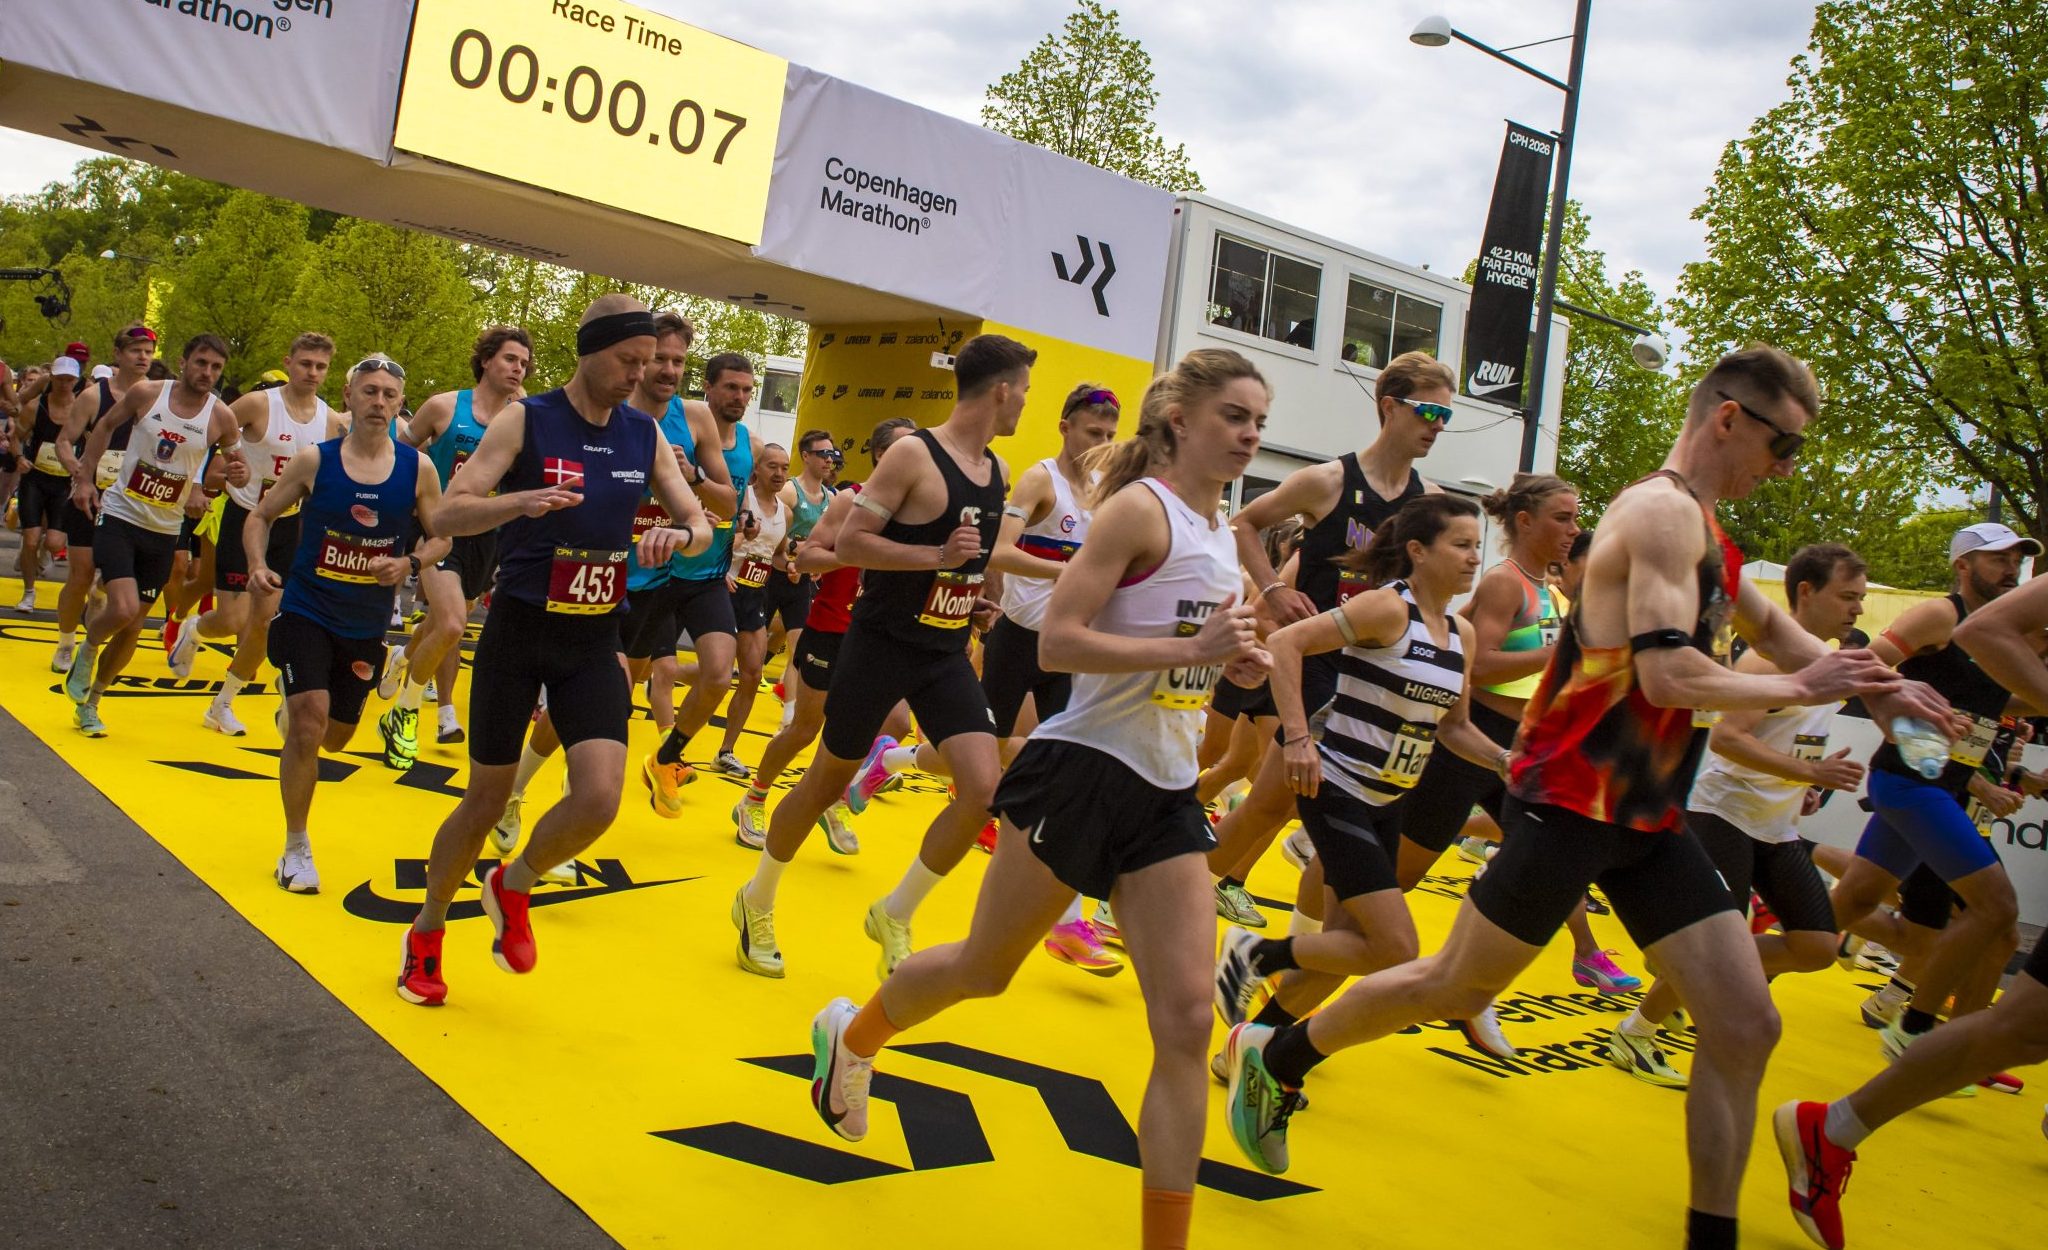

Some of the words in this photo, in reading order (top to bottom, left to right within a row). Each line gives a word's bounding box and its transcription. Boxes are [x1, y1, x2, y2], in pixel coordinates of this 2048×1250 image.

[552, 0, 615, 33] Race
[624, 15, 682, 56] Time
[450, 28, 747, 165] 00:00.07
[1510, 131, 1528, 148] CPH
[1528, 139, 1551, 156] 2026
[825, 157, 957, 216] Copenhagen
[1481, 256, 1502, 271] FAR
[1503, 262, 1536, 279] FROM
[1490, 246, 1511, 261] 42.2
[1513, 250, 1534, 266] KM.
[1486, 270, 1529, 289] HYGGE.
[905, 333, 939, 345] zalando
[1477, 360, 1515, 384] RUN
[921, 388, 953, 400] zalando
[583, 444, 608, 453] CRAFT
[139, 472, 174, 501] Trige
[355, 492, 379, 500] FUSION
[556, 548, 573, 557] CPH
[568, 565, 616, 603] 453
[745, 561, 768, 584] Tran
[394, 858, 634, 889] RN
